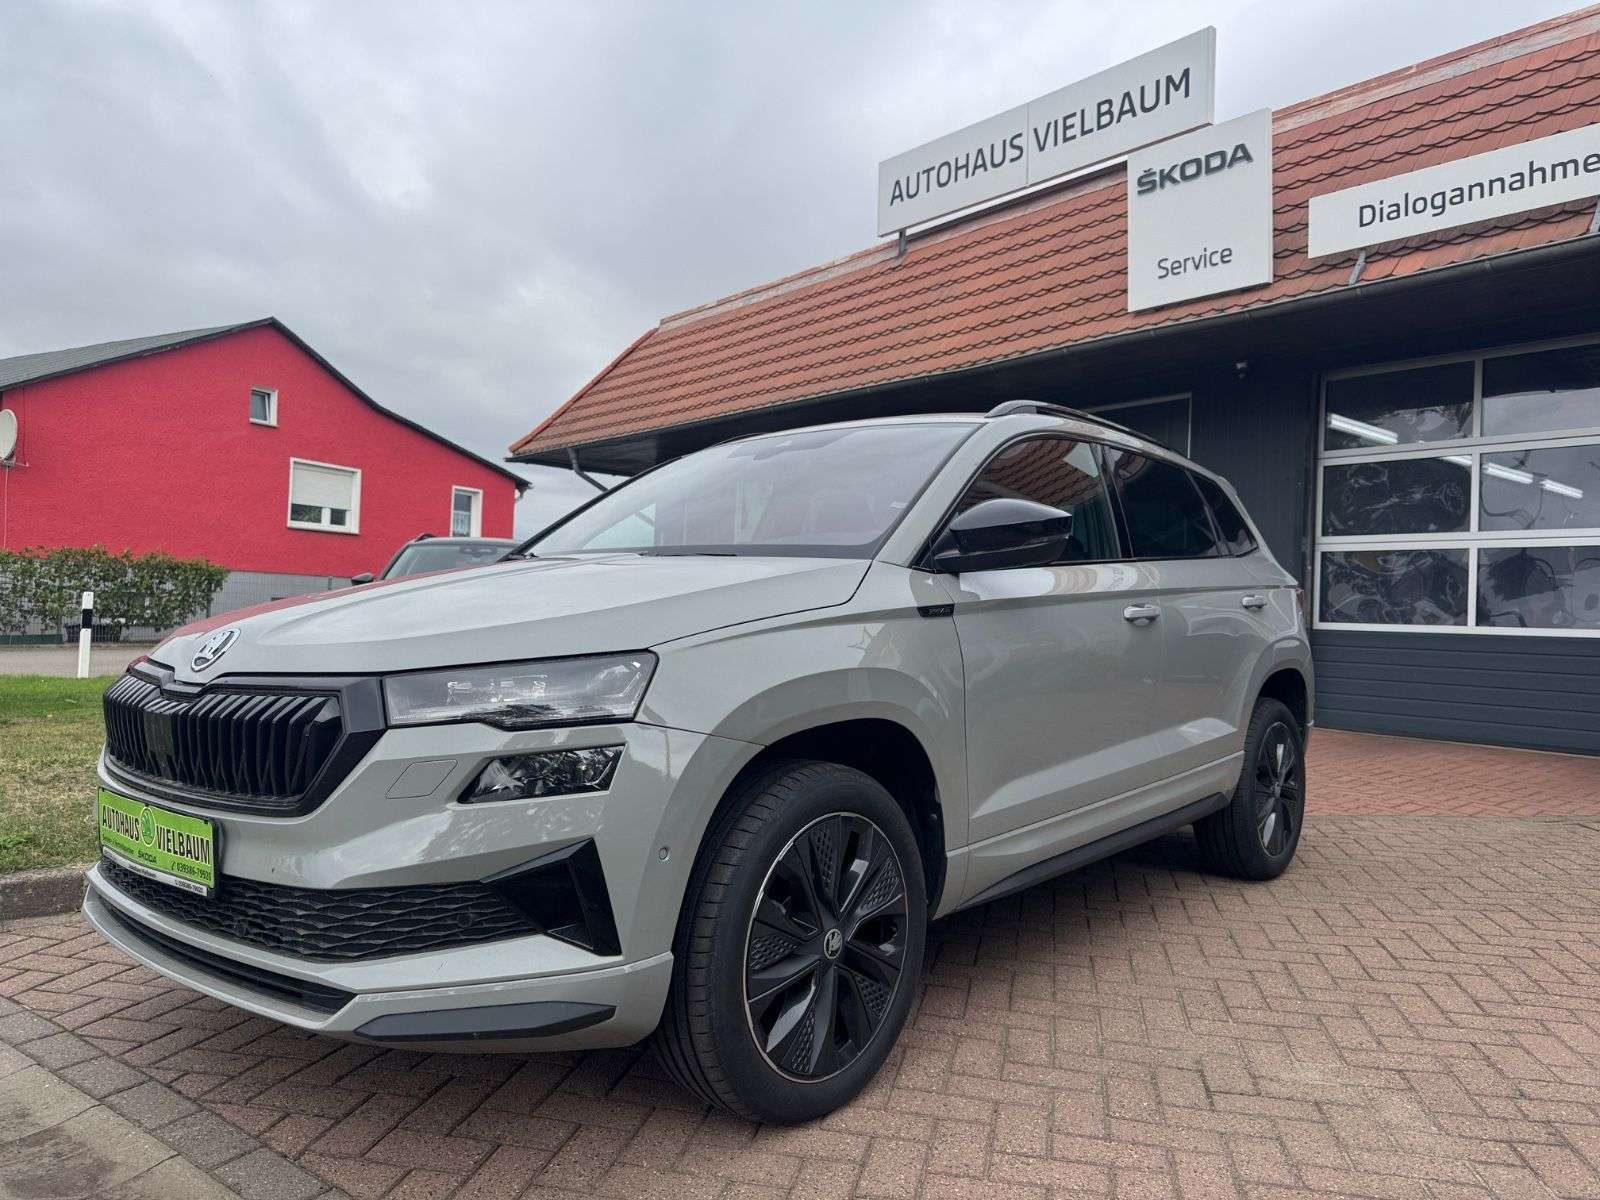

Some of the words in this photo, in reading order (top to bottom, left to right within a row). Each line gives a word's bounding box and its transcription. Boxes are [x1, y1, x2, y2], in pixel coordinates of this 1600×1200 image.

[889, 132, 1025, 207] AUTOHAUS
[1033, 67, 1191, 153] VIELBAUM
[1136, 142, 1254, 197] ŠKODA
[1358, 152, 1600, 229] Dialogannahme
[1157, 246, 1233, 280] Service
[102, 805, 140, 842] AUTOHAUS
[156, 825, 210, 864] VIELBAUM
